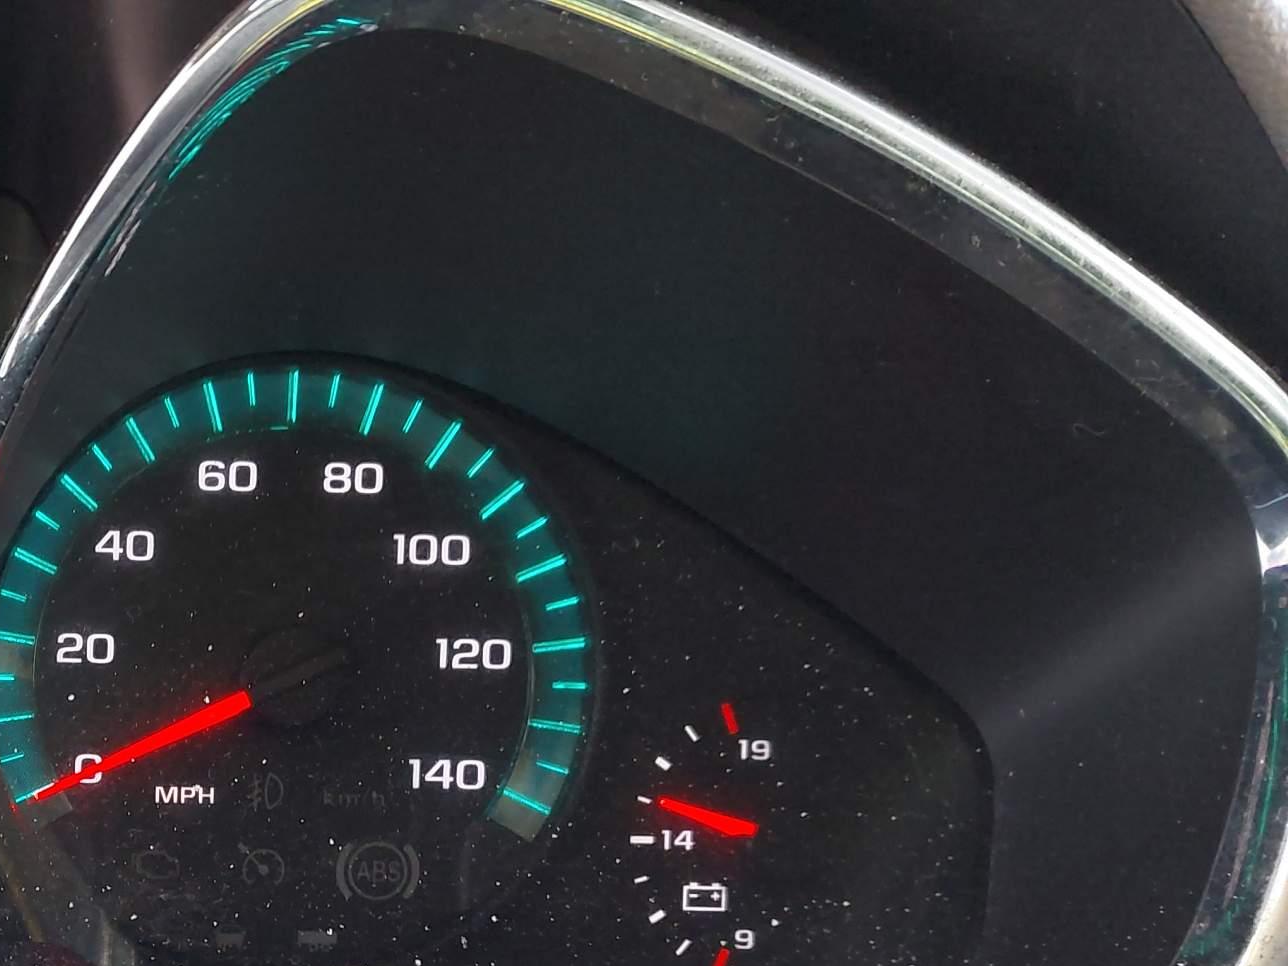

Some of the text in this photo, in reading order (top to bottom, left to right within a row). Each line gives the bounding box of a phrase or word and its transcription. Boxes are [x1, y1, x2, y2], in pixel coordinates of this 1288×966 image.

[198, 460, 258, 492] 60
[323, 462, 384, 494] 80
[94, 530, 155, 561] 40
[393, 534, 470, 566] 100
[56, 632, 115, 664] 20
[435, 638, 512, 670] 120
[738, 739, 770, 761] 19
[408, 758, 485, 790] 140
[155, 784, 215, 804] MPH
[661, 829, 694, 851] 14
[357, 857, 401, 882] ABS
[734, 929, 754, 950] 9
